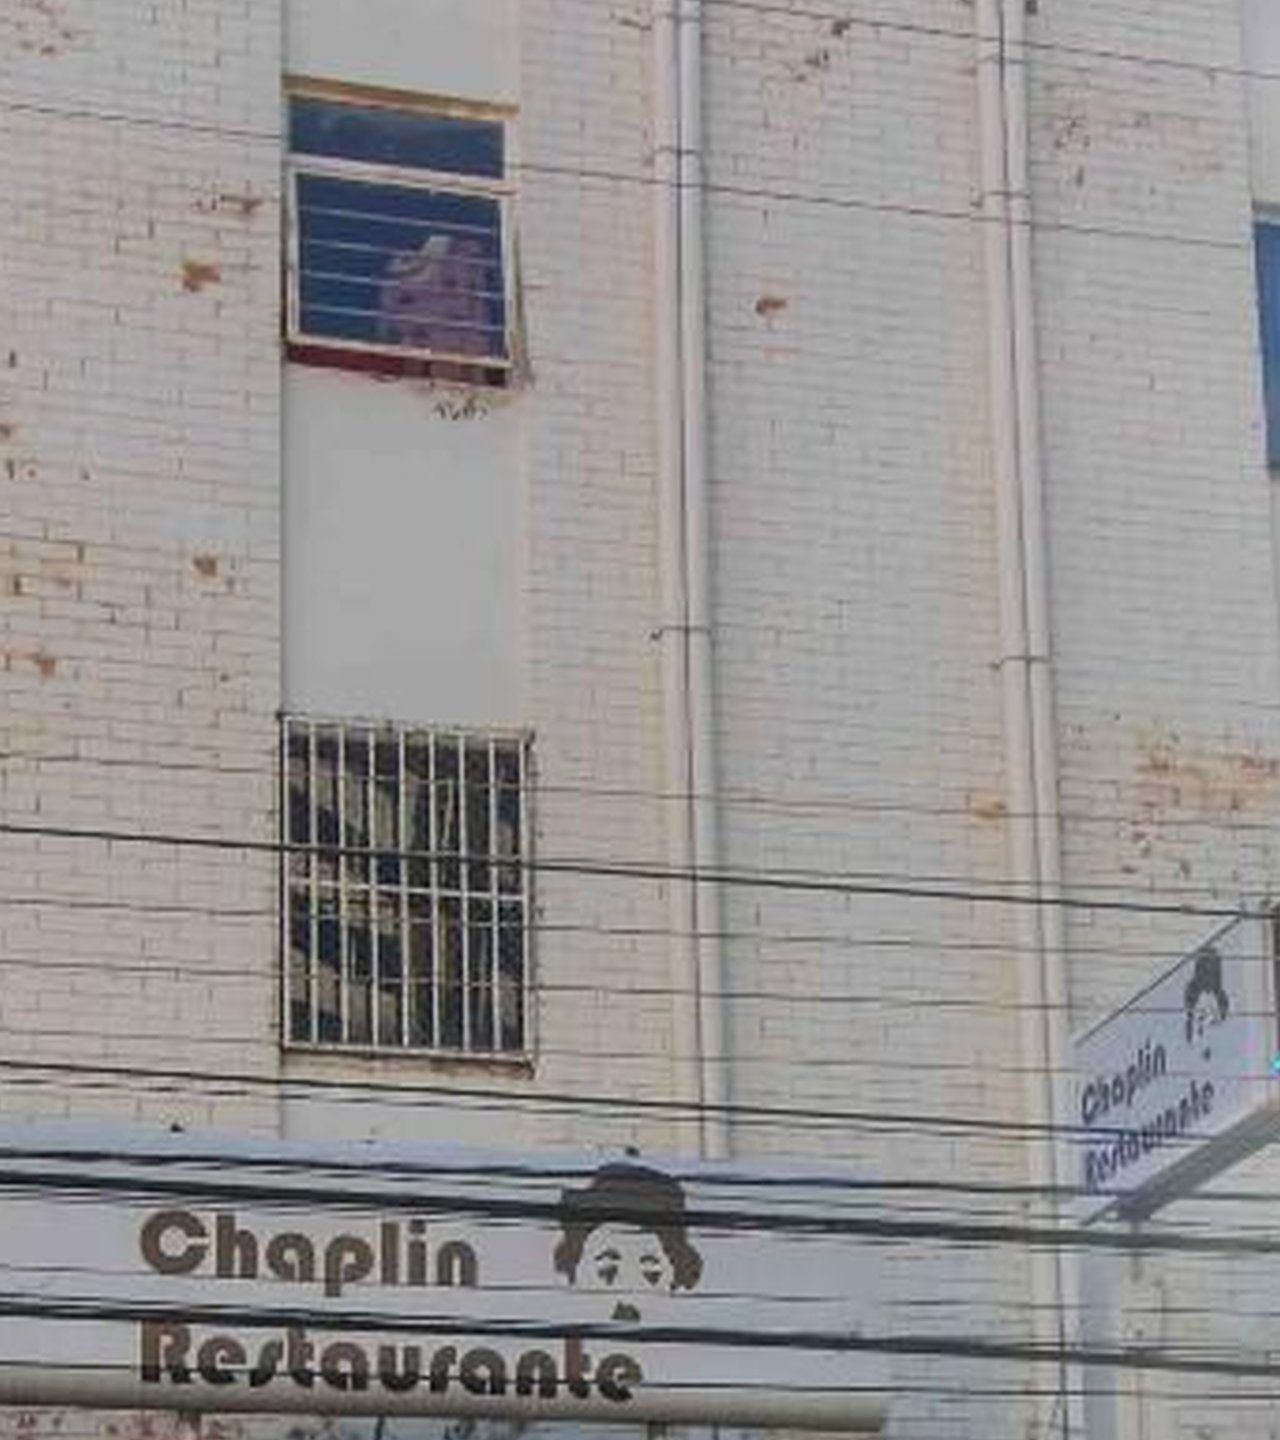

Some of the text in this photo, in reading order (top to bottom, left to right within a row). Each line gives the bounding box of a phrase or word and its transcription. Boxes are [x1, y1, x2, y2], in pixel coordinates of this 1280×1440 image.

[1082, 1036, 1166, 1125] Chaplin
[140, 1209, 478, 1298] Chaplin
[140, 1318, 644, 1402] Restaurante
